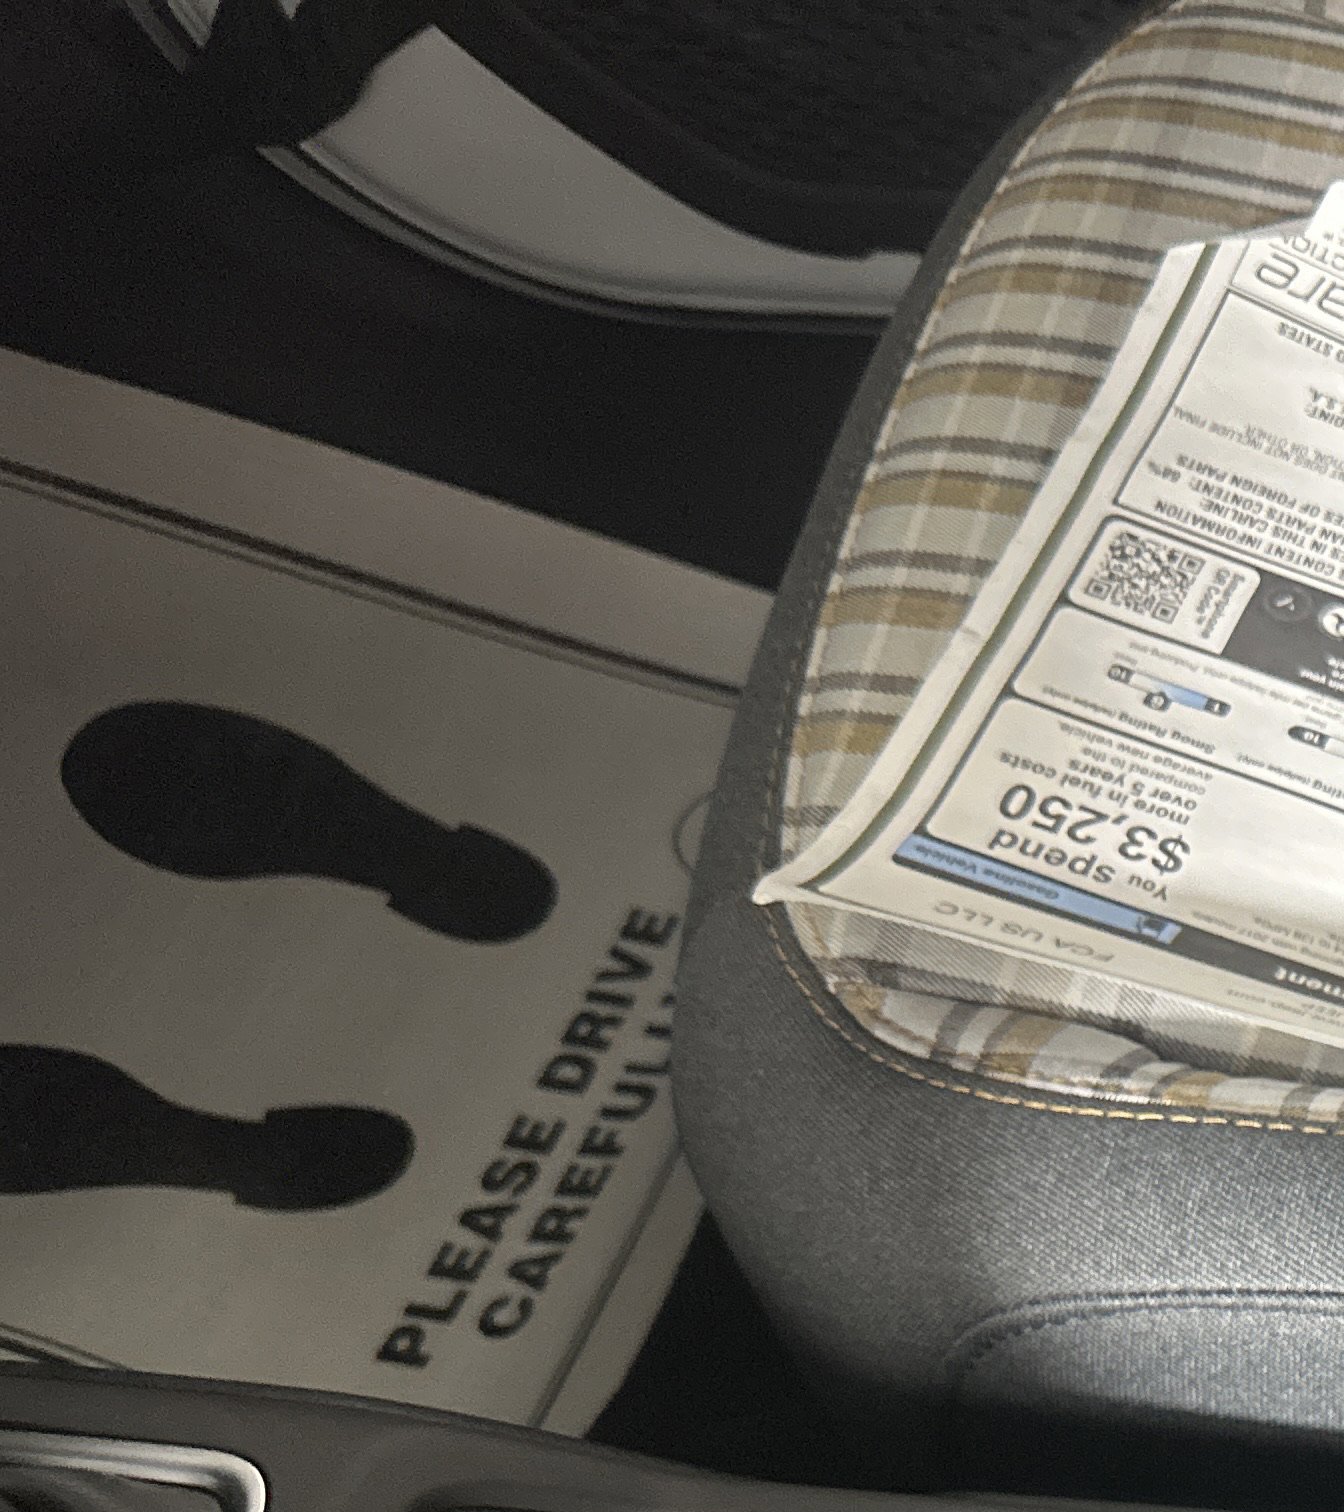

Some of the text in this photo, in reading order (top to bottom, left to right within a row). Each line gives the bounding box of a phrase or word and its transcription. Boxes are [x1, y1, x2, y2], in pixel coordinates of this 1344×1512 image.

[1278, 322, 1333, 357] STATES
[1173, 452, 1228, 483] PARTS
[1230, 474, 1297, 508] FOREIGN
[1298, 501, 1321, 518] OF
[1154, 500, 1262, 548] INFORMATION
[1266, 507, 1316, 535] PARTS
[1271, 525, 1305, 548] THIS
[1265, 543, 1335, 575] CONTENT
[1309, 539, 1327, 554] IN
[999, 751, 1190, 825] more in fuel costs
[1068, 759, 1197, 811] over 5 years
[1000, 784, 1188, 873] $3,250
[988, 829, 1167, 902] You spend
[934, 901, 1114, 962] FCA US LLC
[379, 911, 675, 1366] PLEASE DRIVE
[481, 990, 673, 1338] CAREFUL
